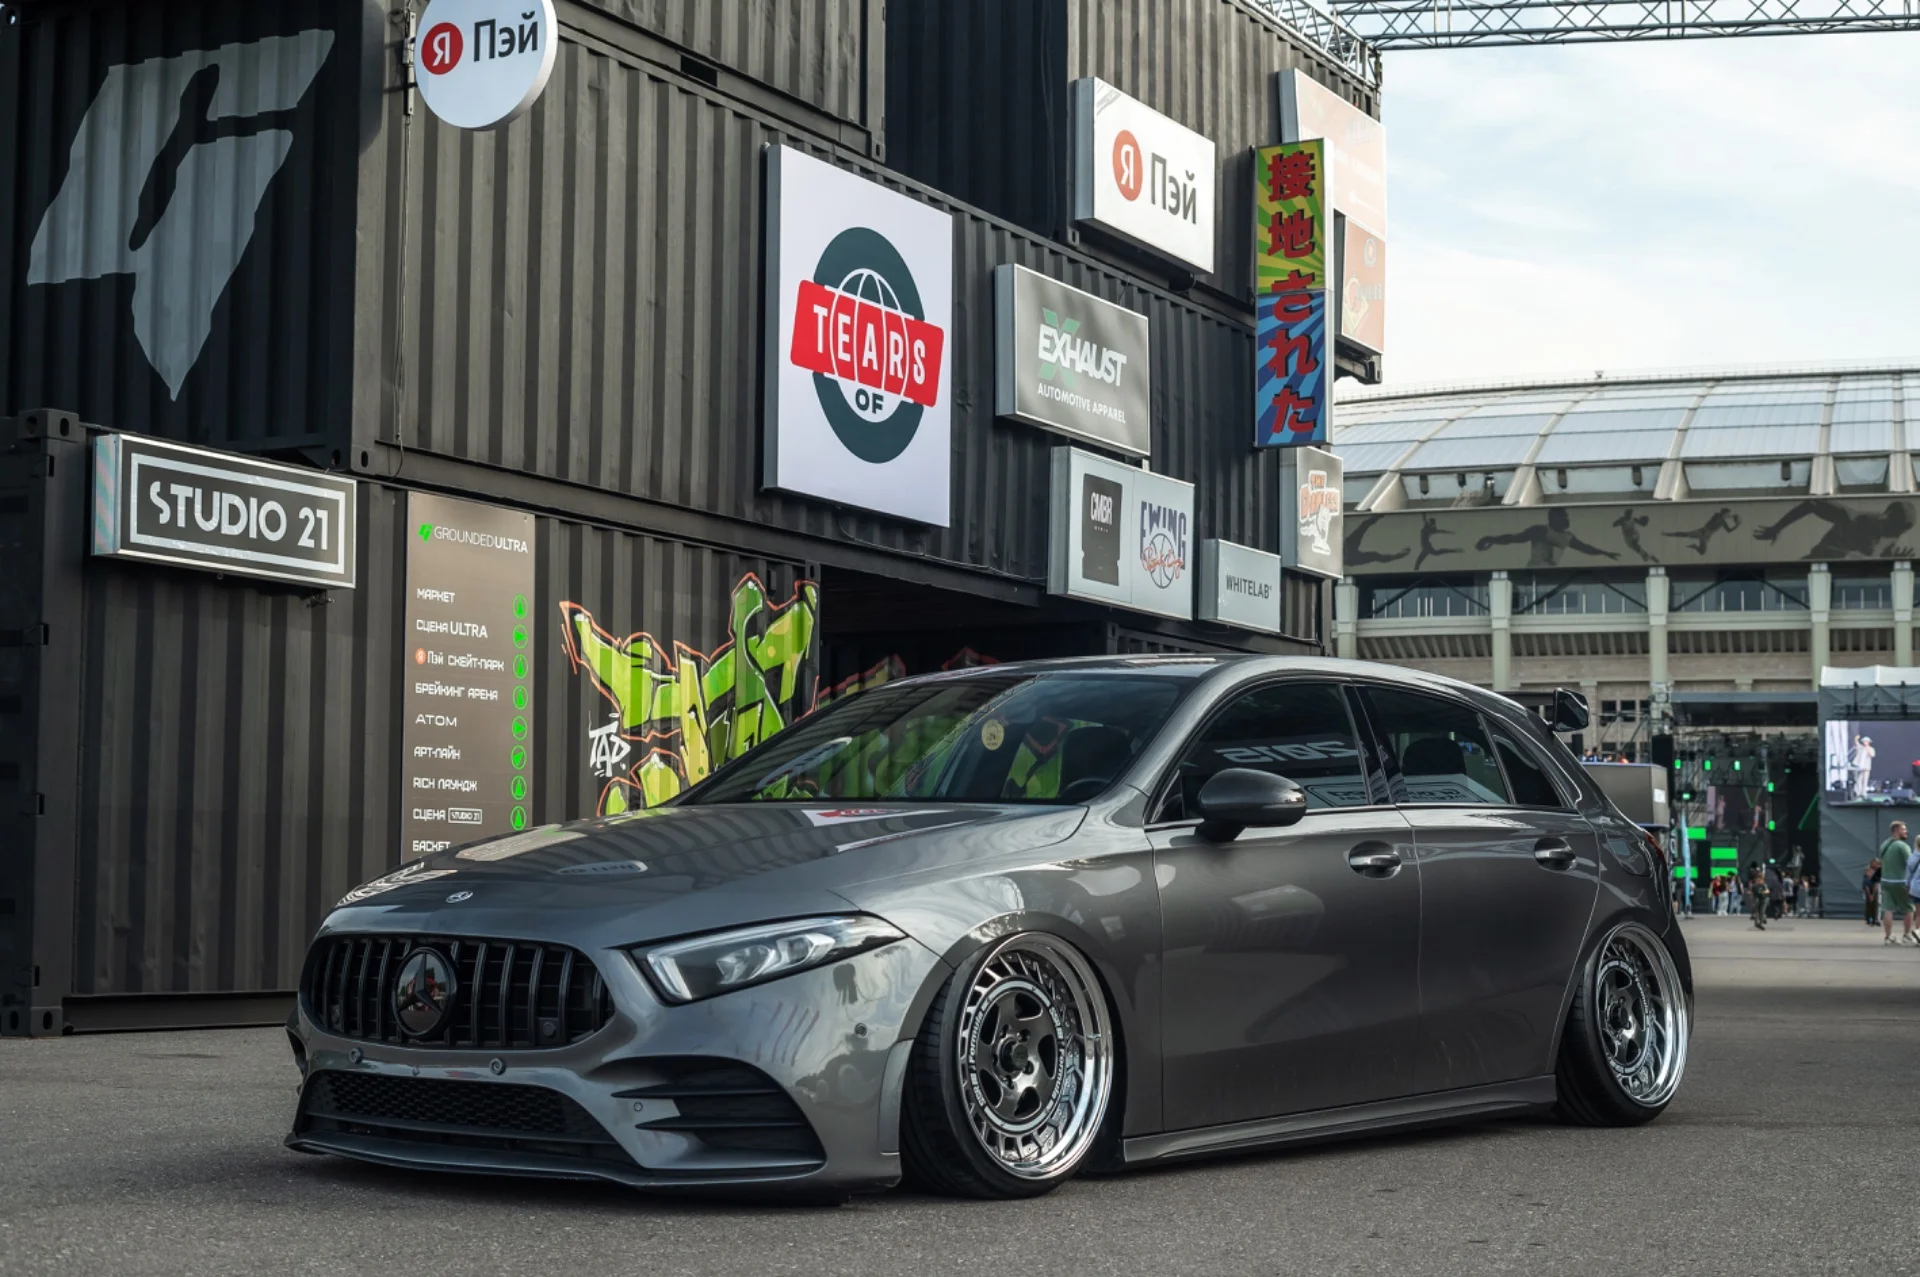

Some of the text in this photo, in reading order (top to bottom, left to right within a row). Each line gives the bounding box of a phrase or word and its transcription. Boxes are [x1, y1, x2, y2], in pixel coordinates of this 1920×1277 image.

[432, 11, 538, 66] Я Пэй
[1120, 144, 1197, 225] Я Пэй
[1267, 150, 1317, 434] 接地された
[812, 304, 926, 385] TEARS
[1038, 323, 1127, 387] EXHAUST
[855, 388, 884, 415] OF
[1037, 382, 1126, 424] AUTOMOTIVE APPAREL
[150, 481, 329, 550] STUDIO 21
[1140, 500, 1187, 571] EWING
[416, 619, 488, 639] СЦЕНА ULTRA
[427, 650, 444, 665] Пэй
[467, 687, 498, 701] АРЕНА
[412, 808, 446, 822] СЦЕНА
[451, 811, 473, 820] STUDIO
